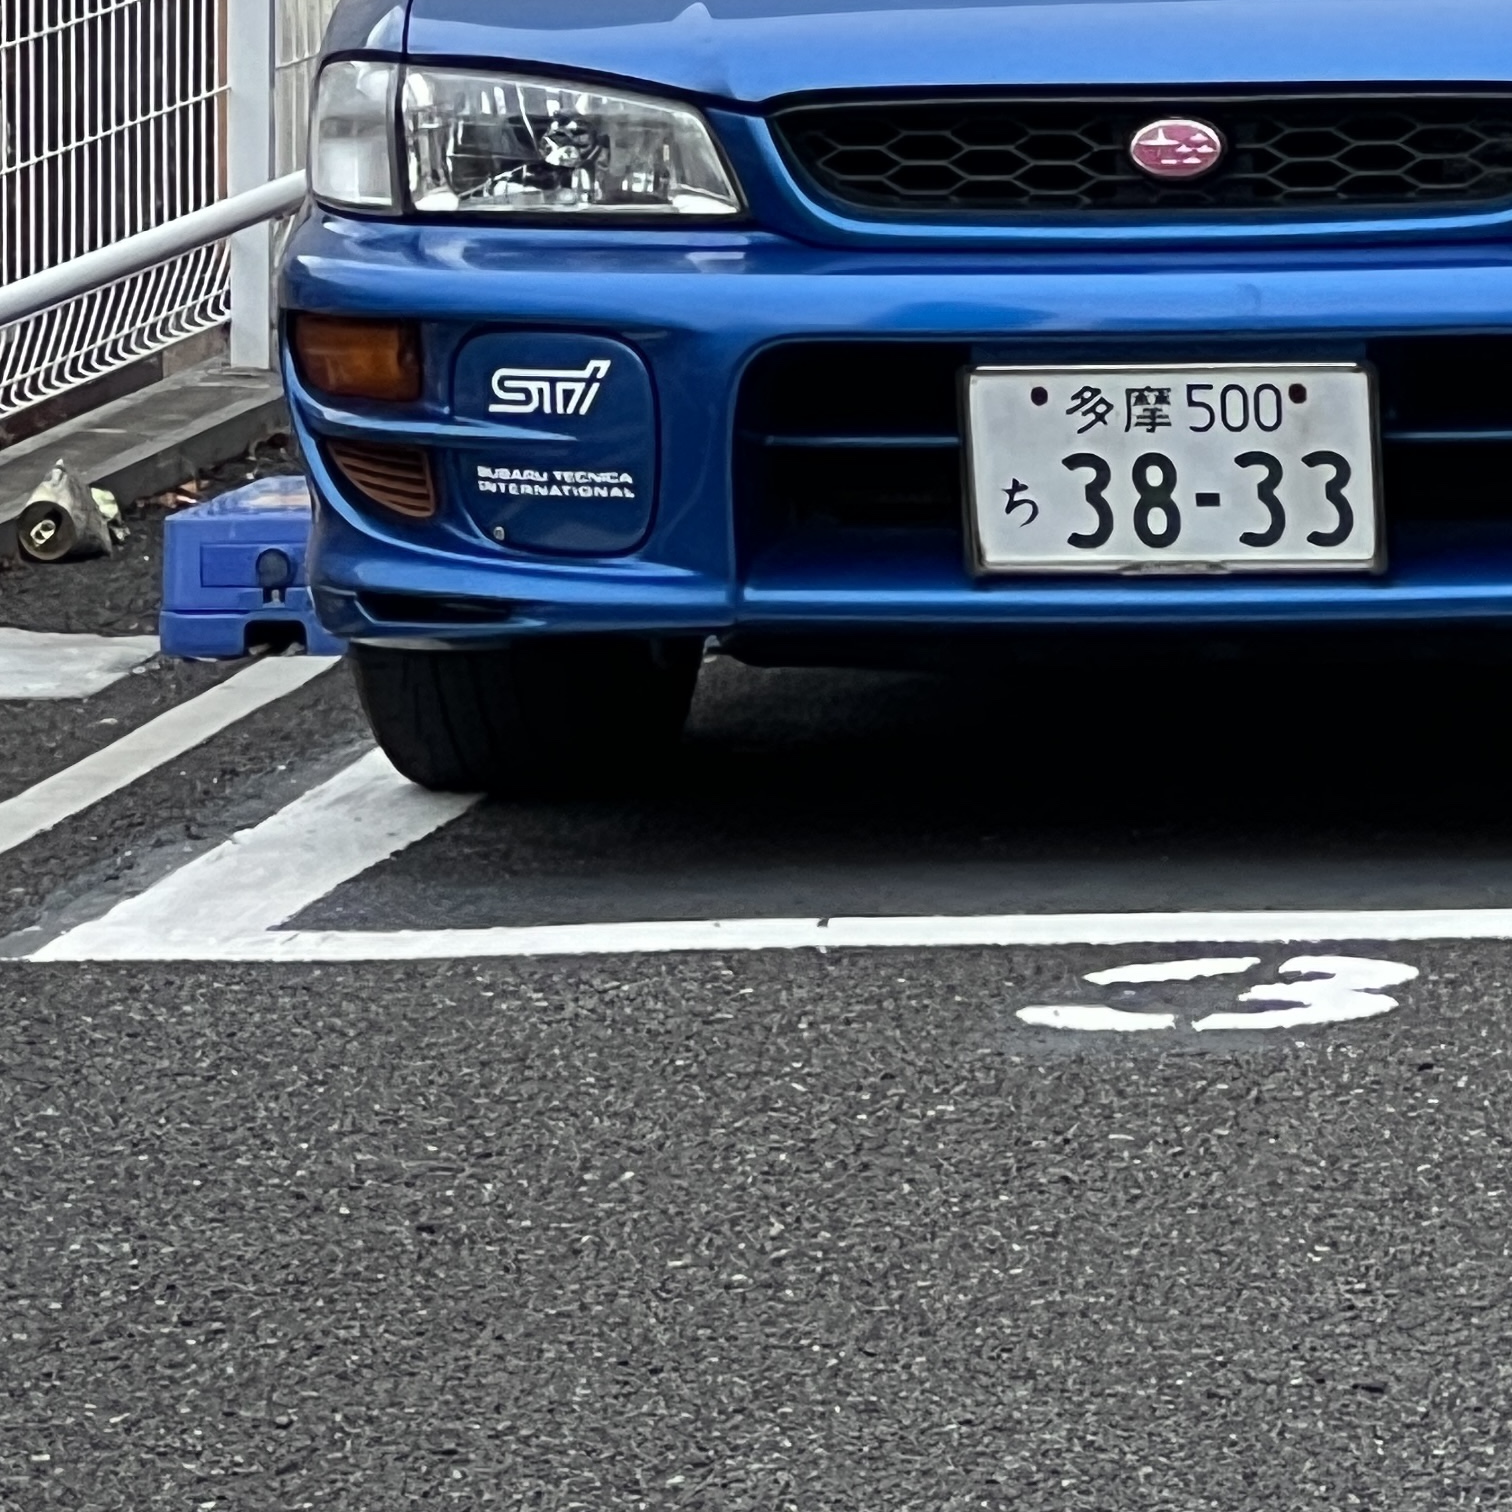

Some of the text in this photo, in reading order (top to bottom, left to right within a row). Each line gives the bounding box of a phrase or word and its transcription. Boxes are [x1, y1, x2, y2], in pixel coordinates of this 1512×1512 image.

[477, 465, 633, 484] SUBARU TECNICA
[478, 480, 635, 499] INTERNATIONAL
[1002, 451, 1354, 549] ち 38-33
